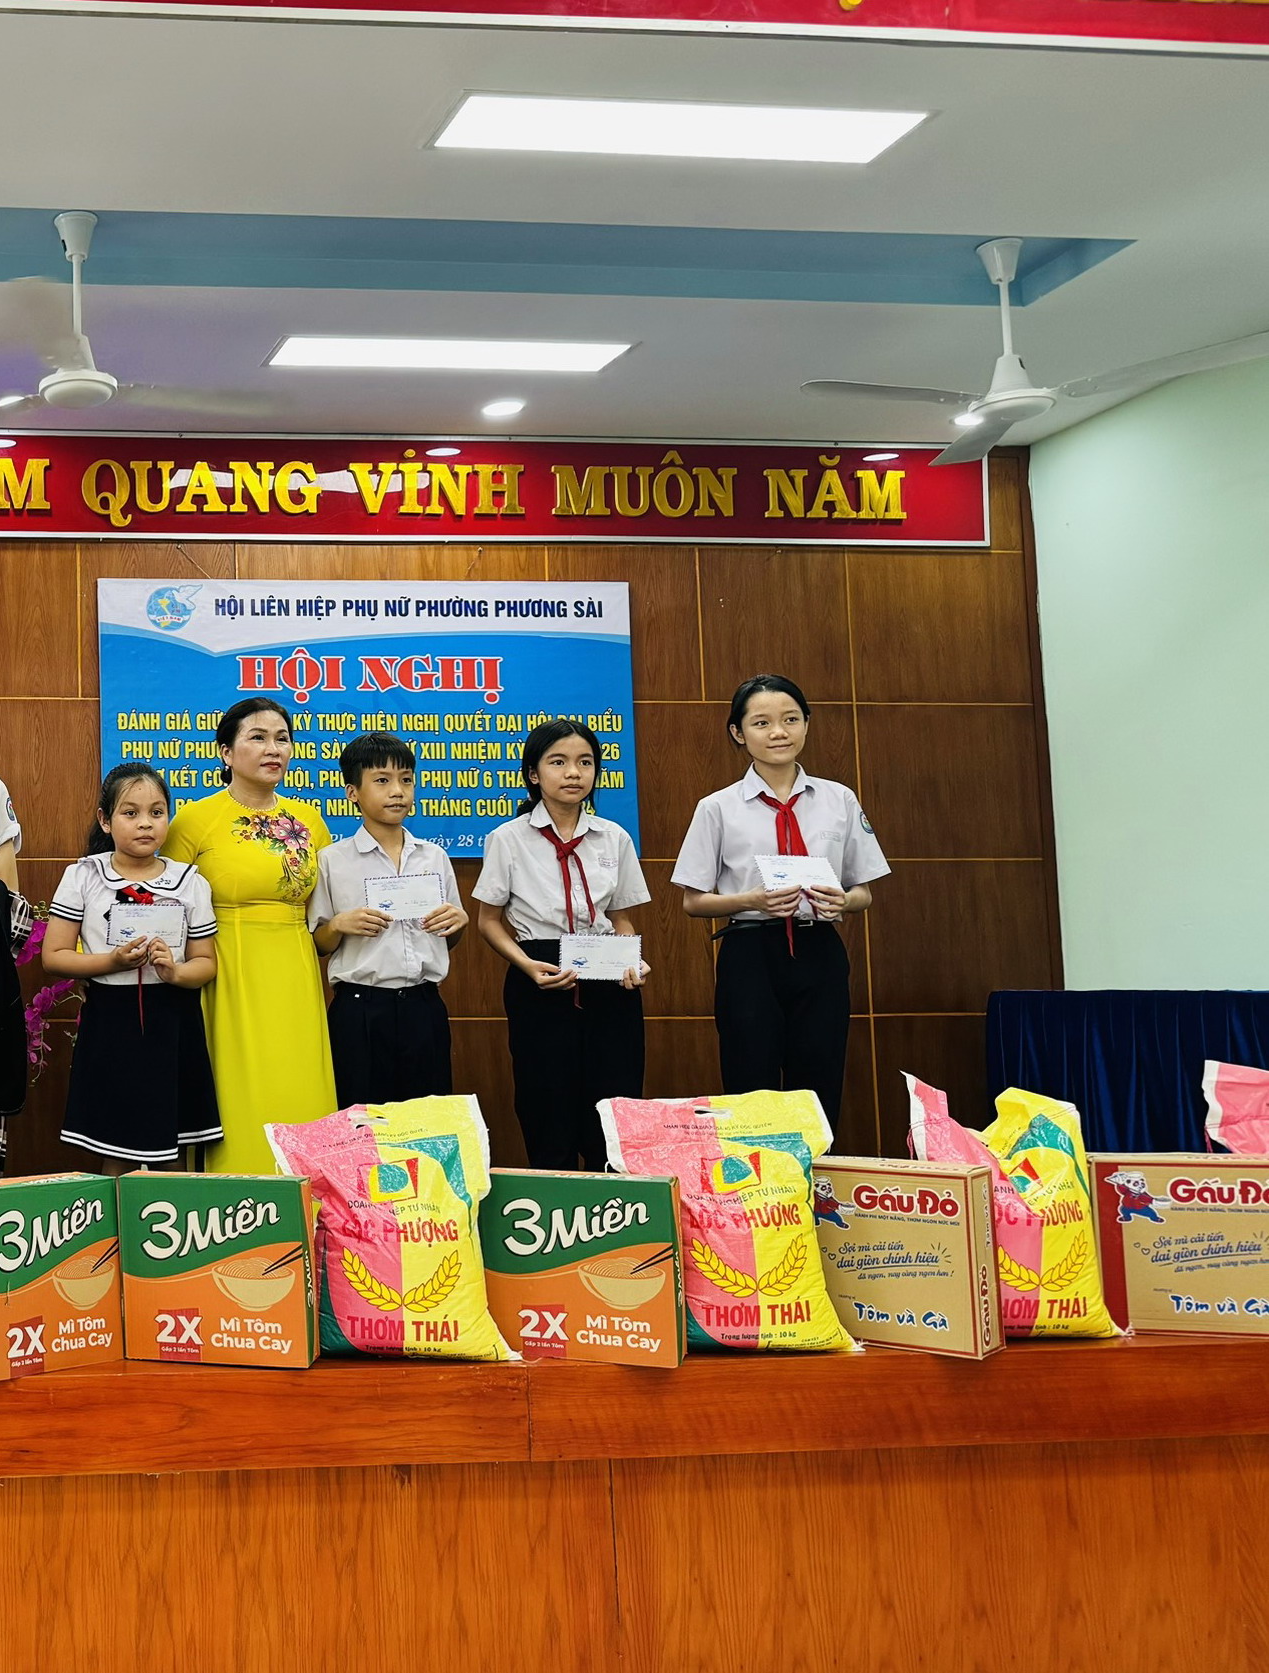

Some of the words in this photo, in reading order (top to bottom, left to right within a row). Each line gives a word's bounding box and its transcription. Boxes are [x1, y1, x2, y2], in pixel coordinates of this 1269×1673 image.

[81, 459, 323, 527] QUANG
[550, 450, 737, 517] MUÔN
[765, 456, 907, 521] NĂM
[215, 595, 245, 620] HỘI
[250, 596, 290, 617] LIÊN
[296, 596, 336, 620] HIỆP
[343, 599, 378, 620] PHỤ
[384, 596, 411, 617] NỮ
[415, 596, 488, 618] PHƯỜNG
[494, 598, 568, 618] PHƯƠNG
[573, 597, 603, 618] SÀI
[237, 647, 346, 704] HỘI
[358, 654, 504, 704] NGHỊ
[117, 709, 160, 731] ĐÁNH
[165, 709, 192, 731] GIÁ
[293, 709, 312, 731] KỲ
[317, 711, 357, 735] THỰC
[402, 713, 440, 735] NGHỊ
[444, 709, 491, 733] QUYẾT
[496, 713, 522, 735] ĐẠI
[587, 708, 623, 732] BIỂU
[122, 741, 153, 762] PHỤ
[158, 738, 181, 759] NỮ
[420, 743, 446, 759] XIII
[451, 739, 502, 763] NHIỆM
[506, 739, 526, 760] KỲ
[170, 765, 198, 787] KẾT
[284, 767, 314, 791] HỘI,
[421, 771, 452, 791] PHỤ
[457, 767, 480, 788] NỮ
[483, 771, 492, 787] 6
[420, 795, 472, 817] THÁNG
[476, 793, 513, 817] CUỐI
[457, 834, 474, 847] 28
[839, 1241, 856, 1254] Sợi
[858, 1242, 874, 1253] mì
[1151, 1250, 1171, 1263] dai
[1201, 1242, 1233, 1257] chính
[837, 1256, 855, 1268] dai
[856, 1255, 880, 1270] giòn
[882, 1252, 913, 1264] chính
[915, 1251, 939, 1266] hiệu
[702, 1302, 761, 1328] THƠM
[767, 1296, 811, 1326] THÁI
[853, 1302, 890, 1322] Tôm
[896, 1308, 916, 1326] và
[922, 1311, 949, 1331] Gà
[1047, 1291, 1087, 1319] THÁI
[1170, 1295, 1209, 1312] Tôm
[1216, 1298, 1237, 1314] và
[58, 1318, 75, 1335] Mì
[77, 1316, 106, 1331] Tôm
[155, 1314, 204, 1345] 2X
[220, 1317, 241, 1333] Mì
[244, 1318, 282, 1334] Tôm
[347, 1315, 404, 1341] THƠM
[412, 1314, 459, 1342] THÁI
[518, 1309, 569, 1341] 2X
[586, 1314, 608, 1330] Mì
[610, 1316, 651, 1333] Tôm
[6, 1324, 46, 1359] 2X
[51, 1336, 86, 1353] Chua
[88, 1332, 113, 1348] Cay
[211, 1334, 256, 1349] Chua
[259, 1336, 292, 1354] Cay
[576, 1330, 623, 1347] Chua
[626, 1334, 661, 1353] Cay
